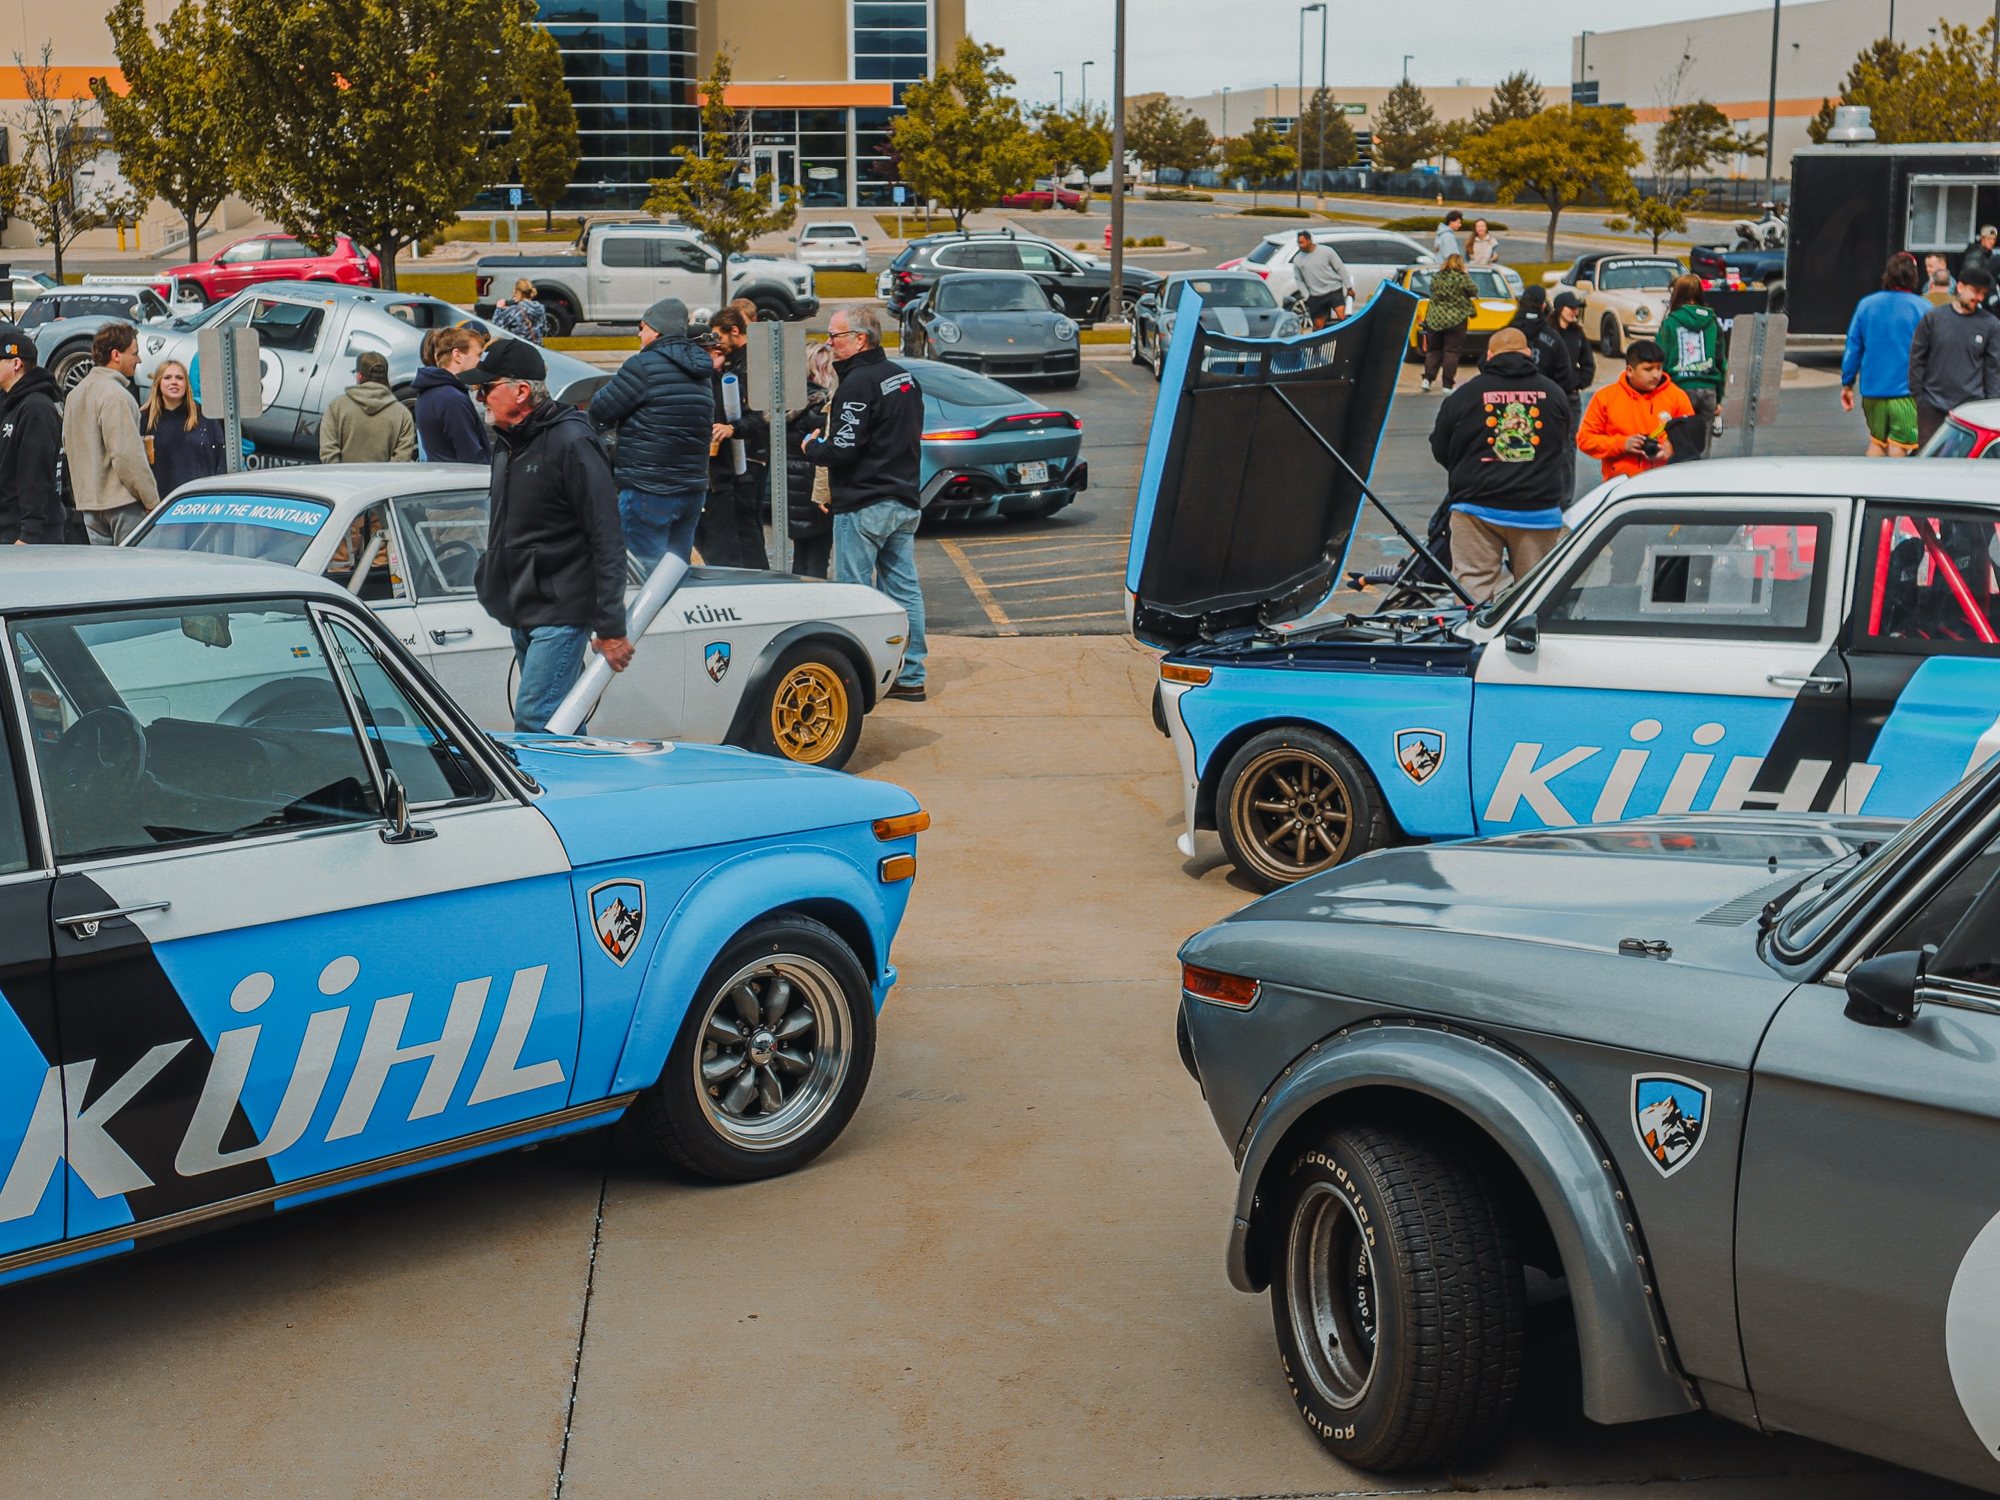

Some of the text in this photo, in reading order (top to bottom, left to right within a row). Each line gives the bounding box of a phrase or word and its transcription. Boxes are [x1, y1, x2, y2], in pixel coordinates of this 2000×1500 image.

[171, 503, 322, 526] BORN IN THE MOUNTAINS
[683, 604, 743, 625] KÜHL
[0, 955, 566, 1223] KÜHL
